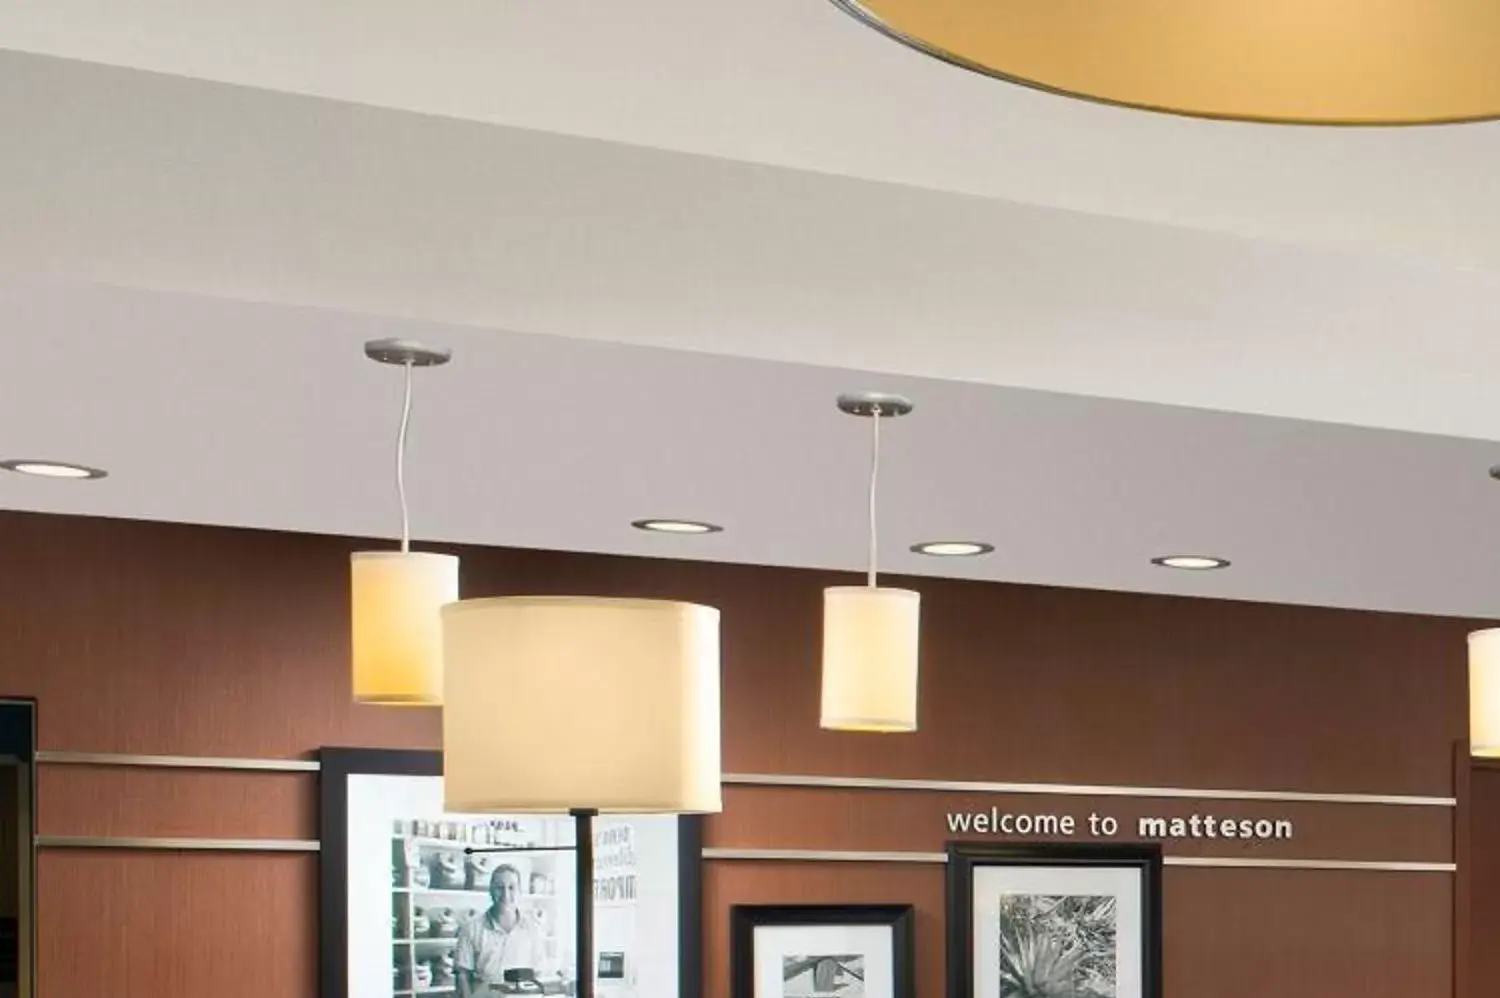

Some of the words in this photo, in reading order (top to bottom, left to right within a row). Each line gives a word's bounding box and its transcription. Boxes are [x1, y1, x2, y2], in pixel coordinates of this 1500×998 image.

[946, 807, 1075, 835] welcome
[1088, 812, 1118, 835] to
[1139, 814, 1293, 840] matteson
